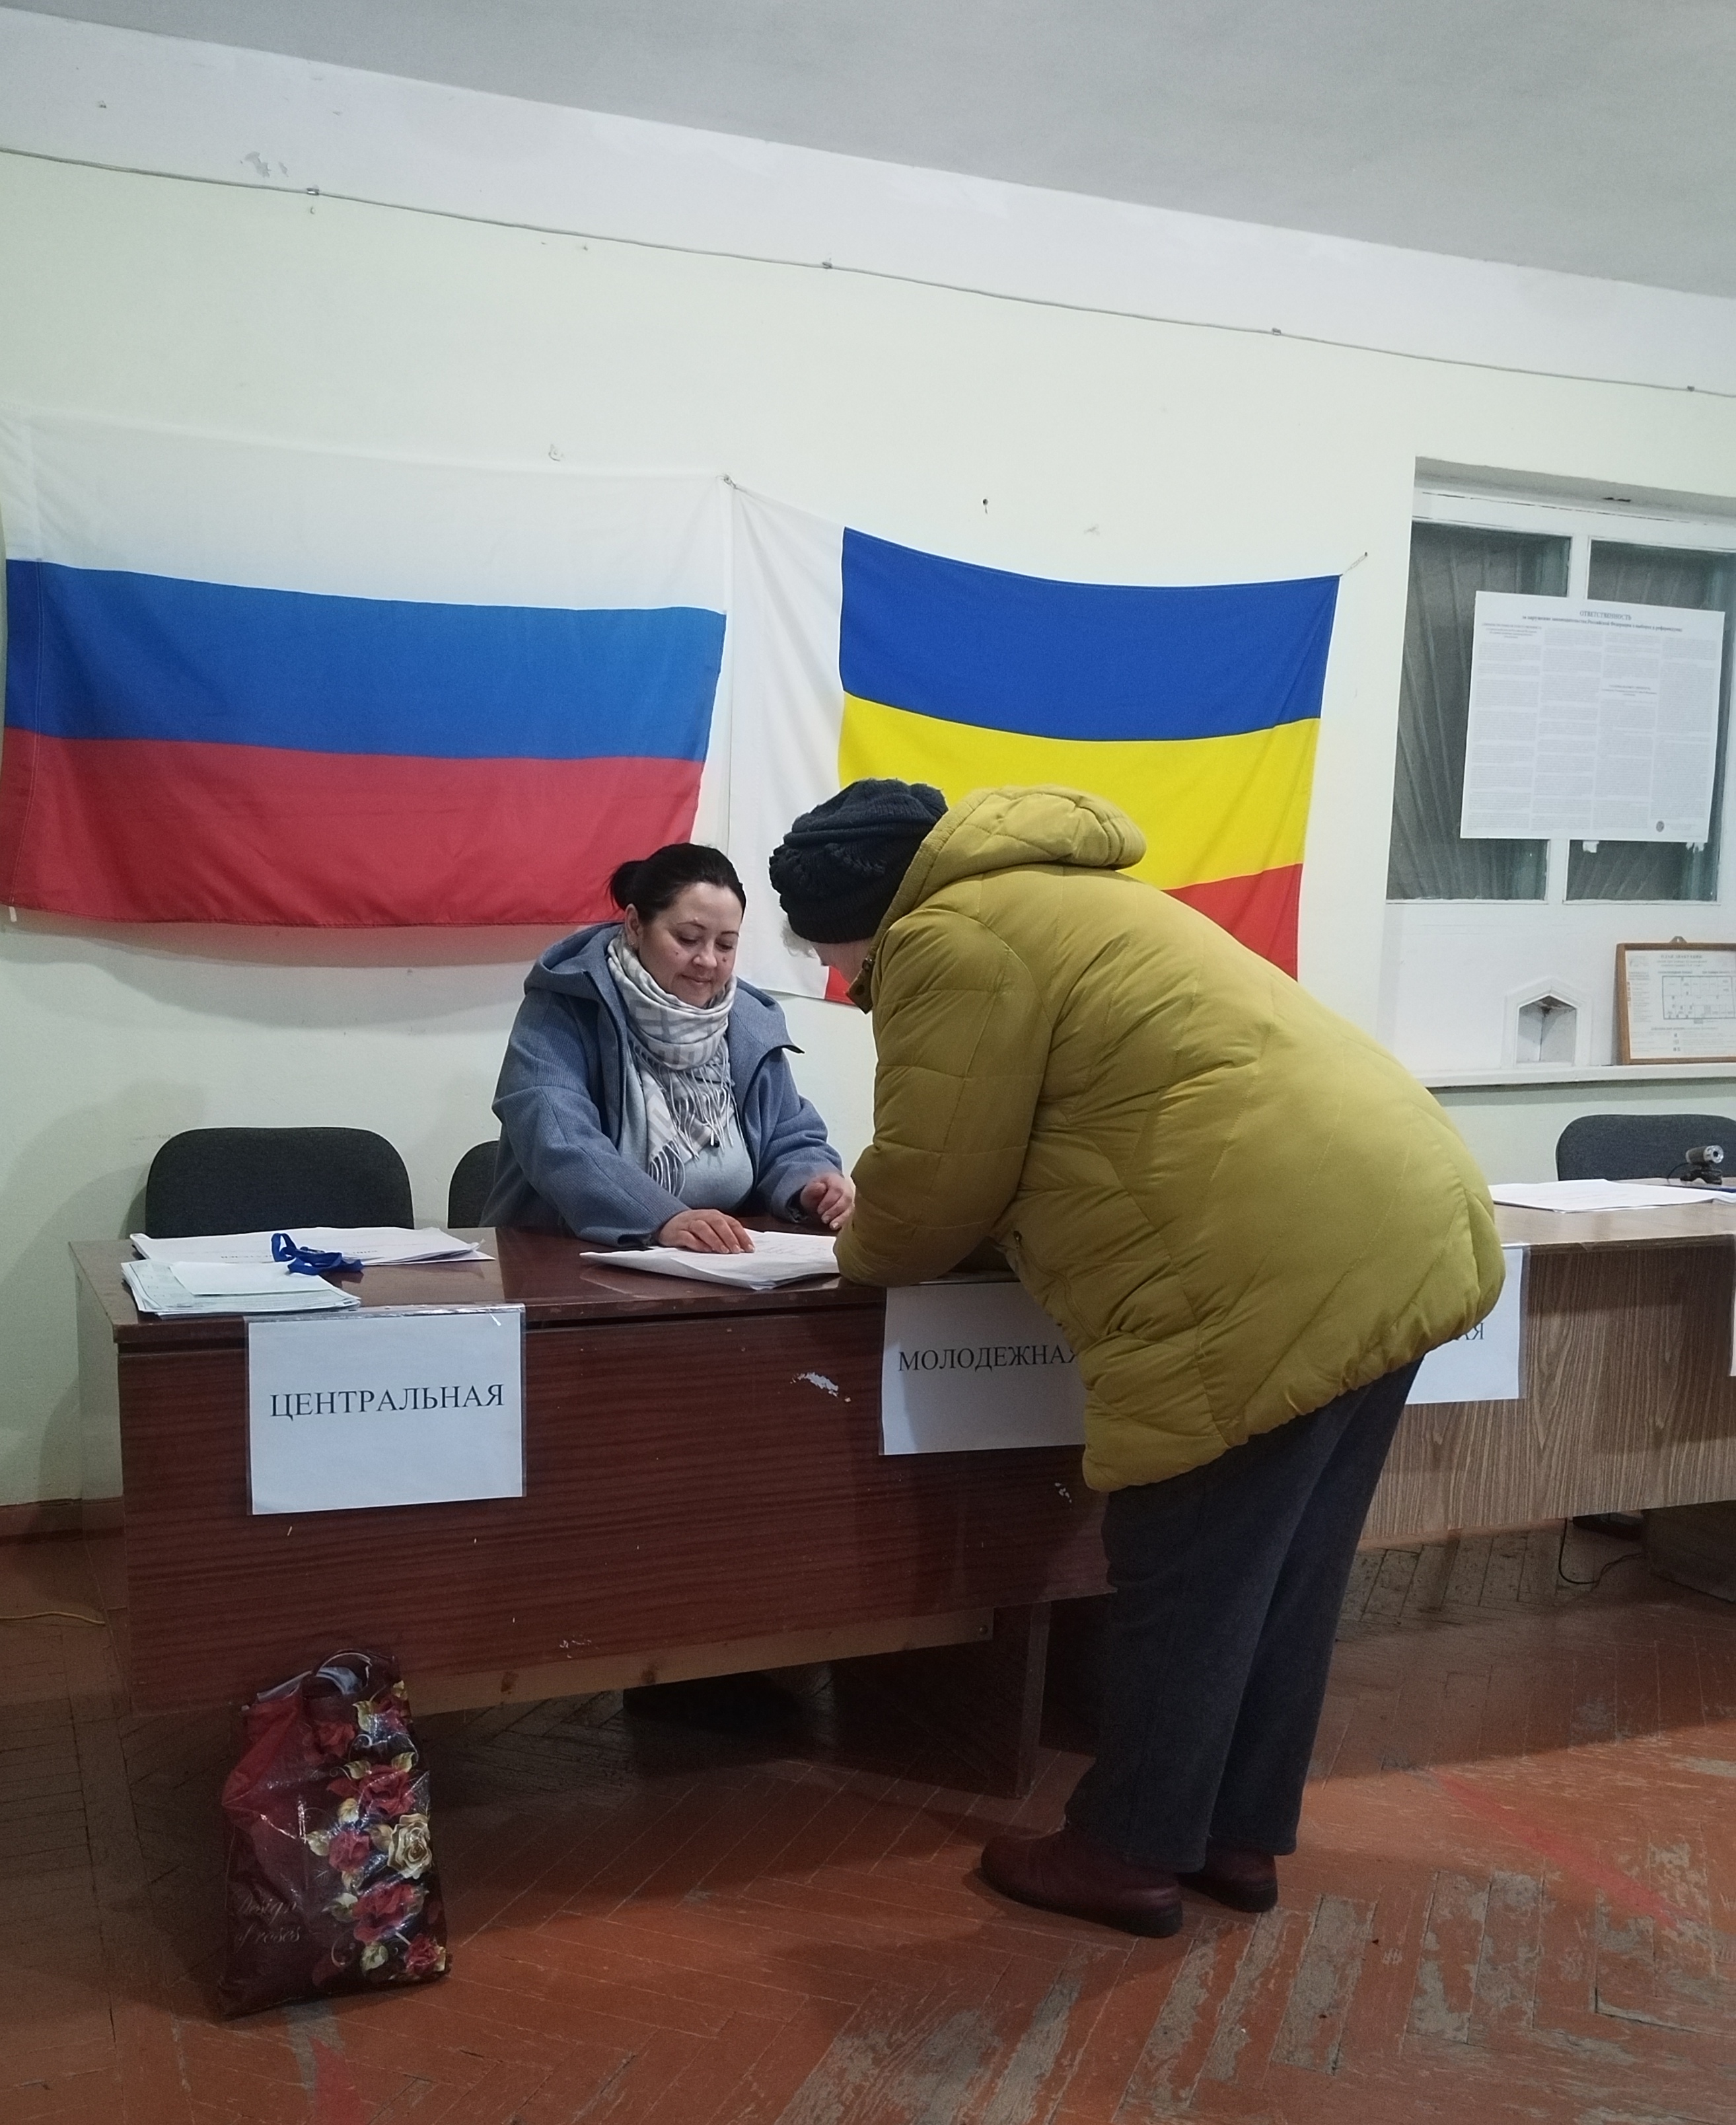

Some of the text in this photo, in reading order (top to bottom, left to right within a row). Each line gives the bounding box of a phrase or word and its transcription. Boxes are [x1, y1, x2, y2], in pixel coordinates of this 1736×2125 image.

[1579, 611, 1632, 620] ОТВЕТСТВЕННОСТЬ
[270, 1383, 505, 1422] ЦЕНТРАЛЬНАЯ
[256, 1926, 301, 1943] roses
